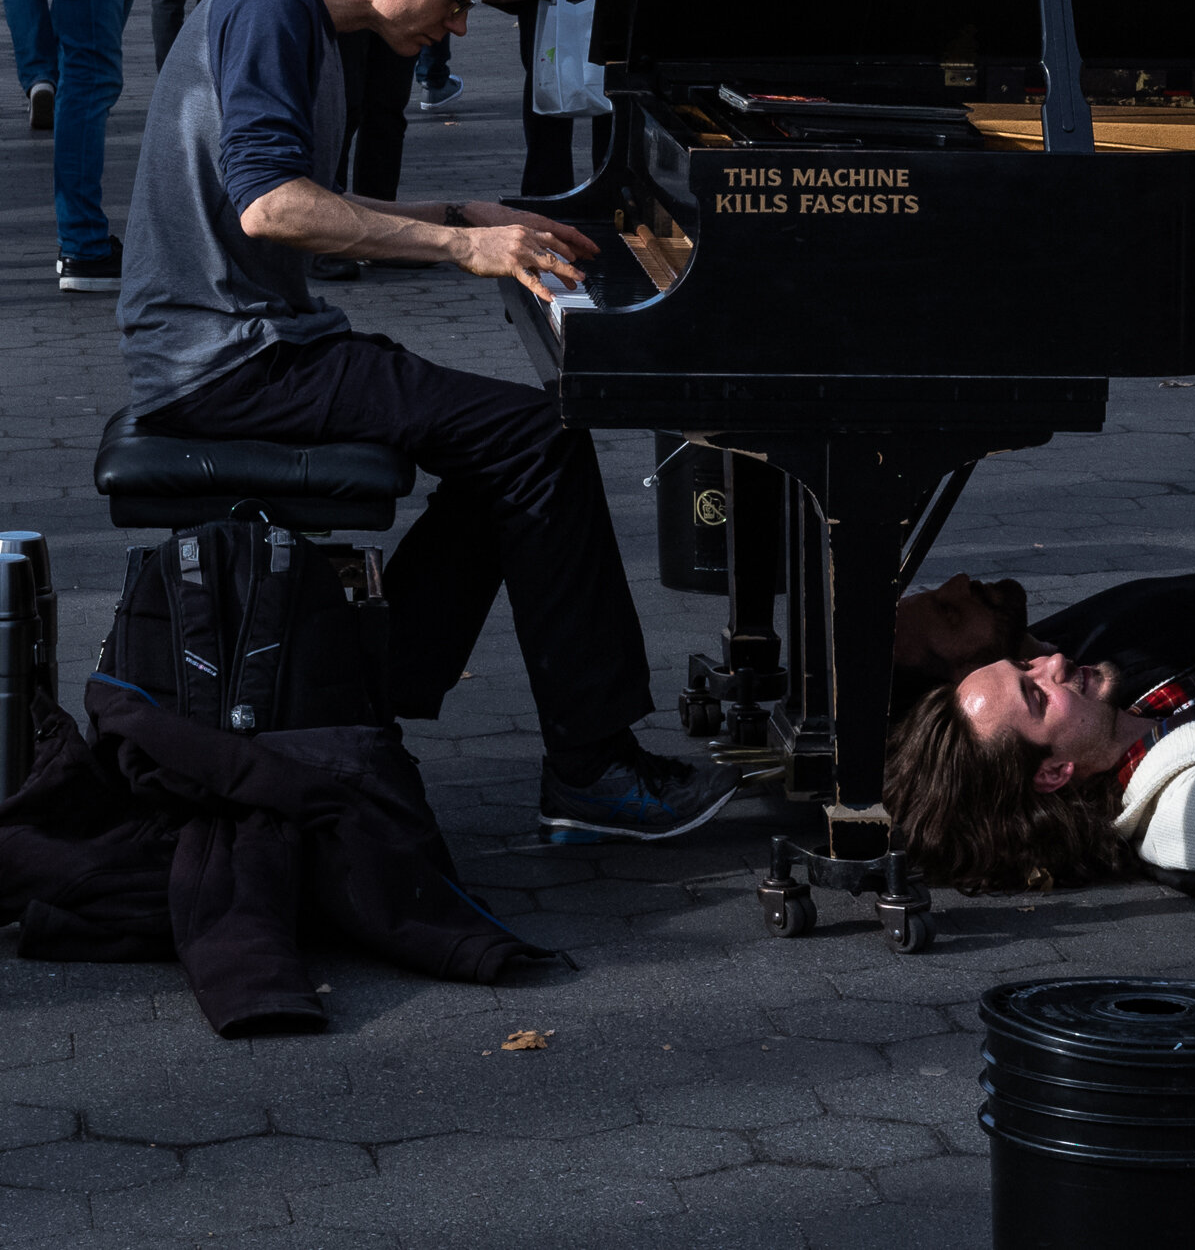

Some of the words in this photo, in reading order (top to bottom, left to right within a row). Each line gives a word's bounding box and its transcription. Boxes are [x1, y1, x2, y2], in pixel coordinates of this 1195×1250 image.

[723, 167, 783, 187] THIS
[791, 167, 910, 188] MACHINE
[715, 193, 789, 214] KILLS
[799, 193, 920, 214] FASCISTS
